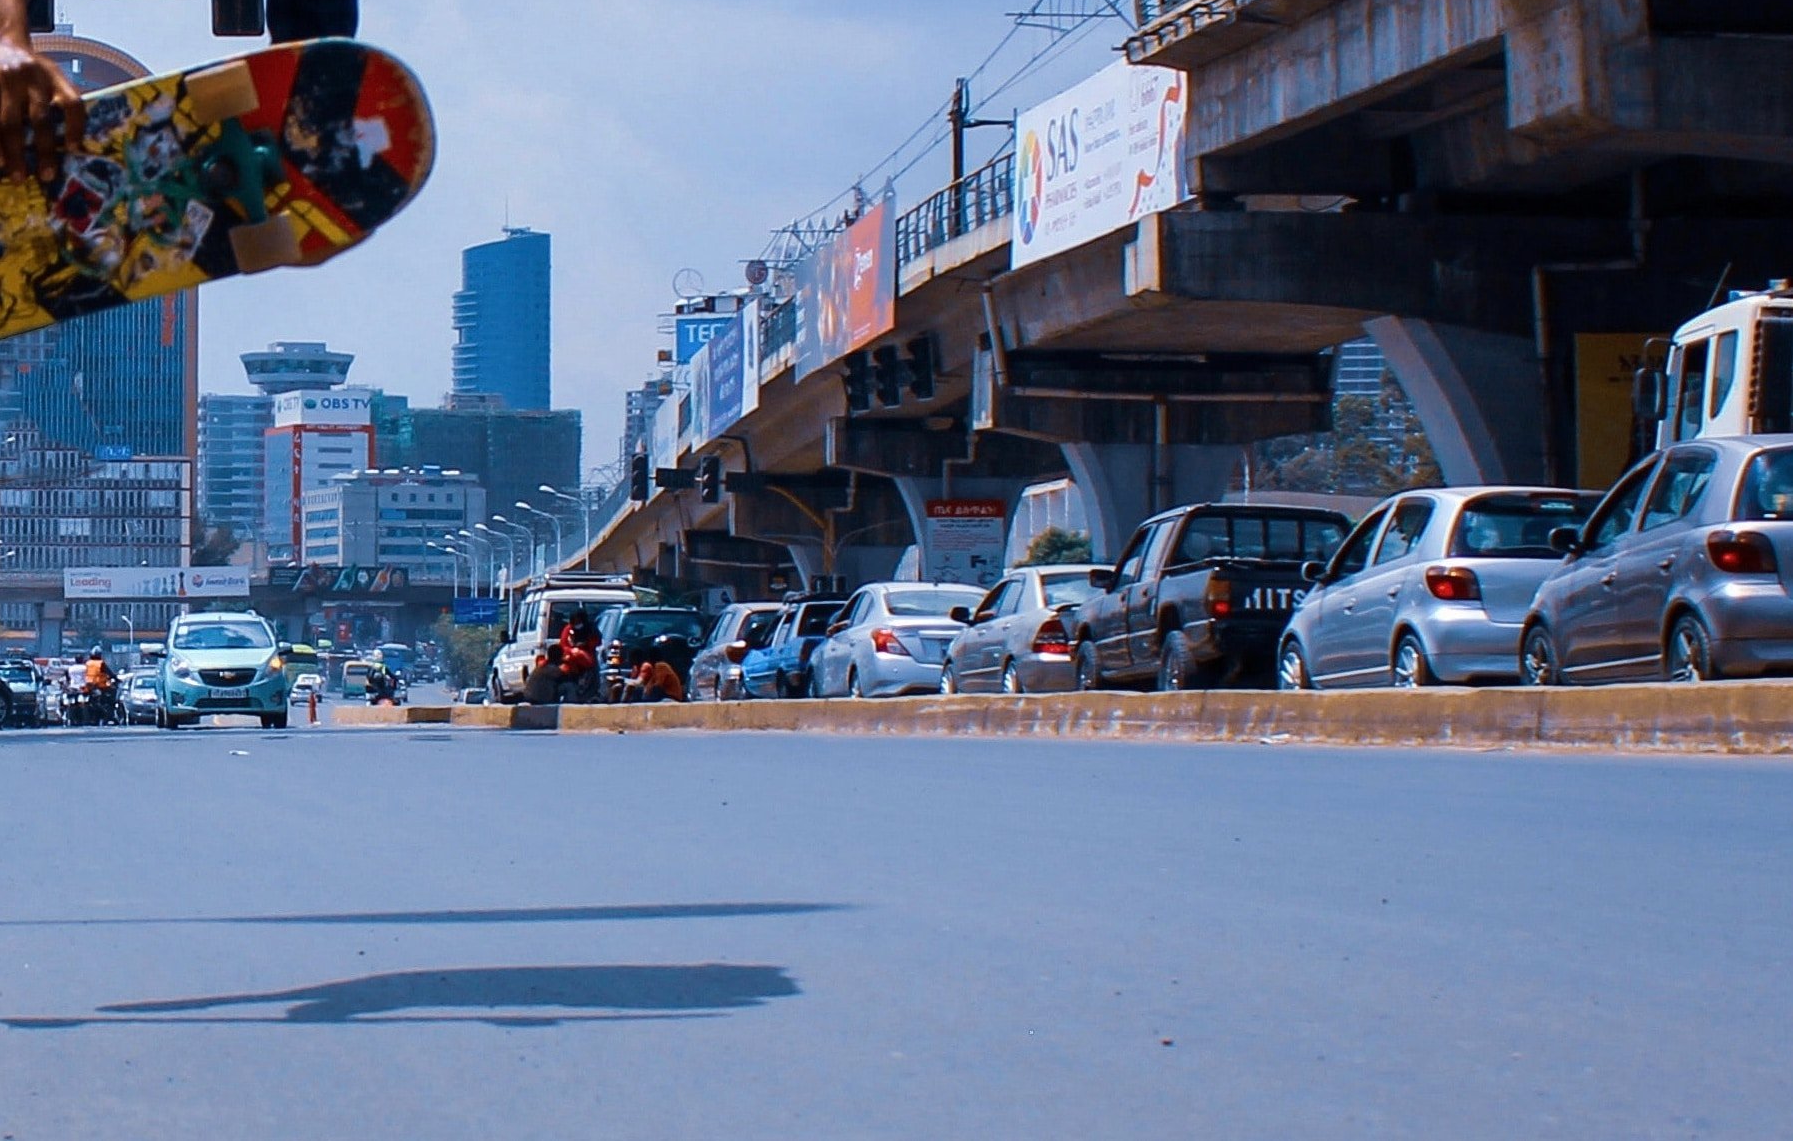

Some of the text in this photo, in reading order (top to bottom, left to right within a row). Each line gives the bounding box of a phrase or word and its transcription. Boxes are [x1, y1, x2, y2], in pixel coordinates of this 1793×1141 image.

[1046, 107, 1080, 182] SAS
[320, 397, 373, 409] OBS TV
[69, 577, 112, 589] Leading
